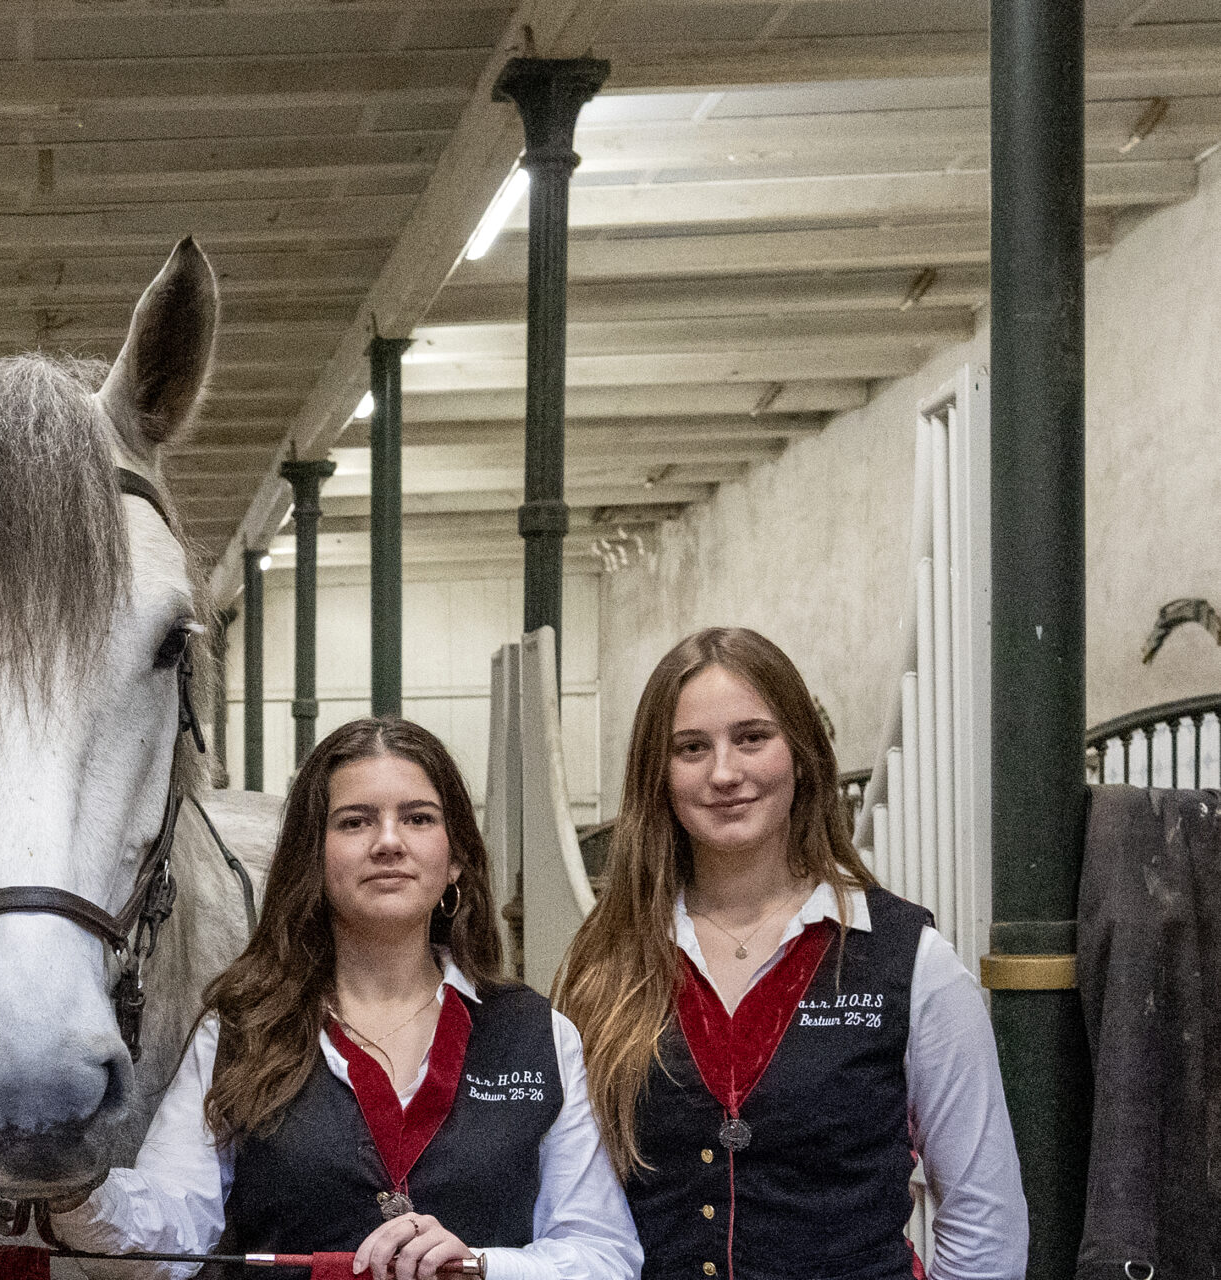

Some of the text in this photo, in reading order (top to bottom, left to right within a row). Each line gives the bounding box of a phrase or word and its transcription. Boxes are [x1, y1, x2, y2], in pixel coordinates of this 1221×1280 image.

[799, 1011, 882, 1028] Bestuur '25-'26
[497, 1070, 546, 1086] H.O.R.S.
[469, 1086, 544, 1102] Bestuur '25-'26
